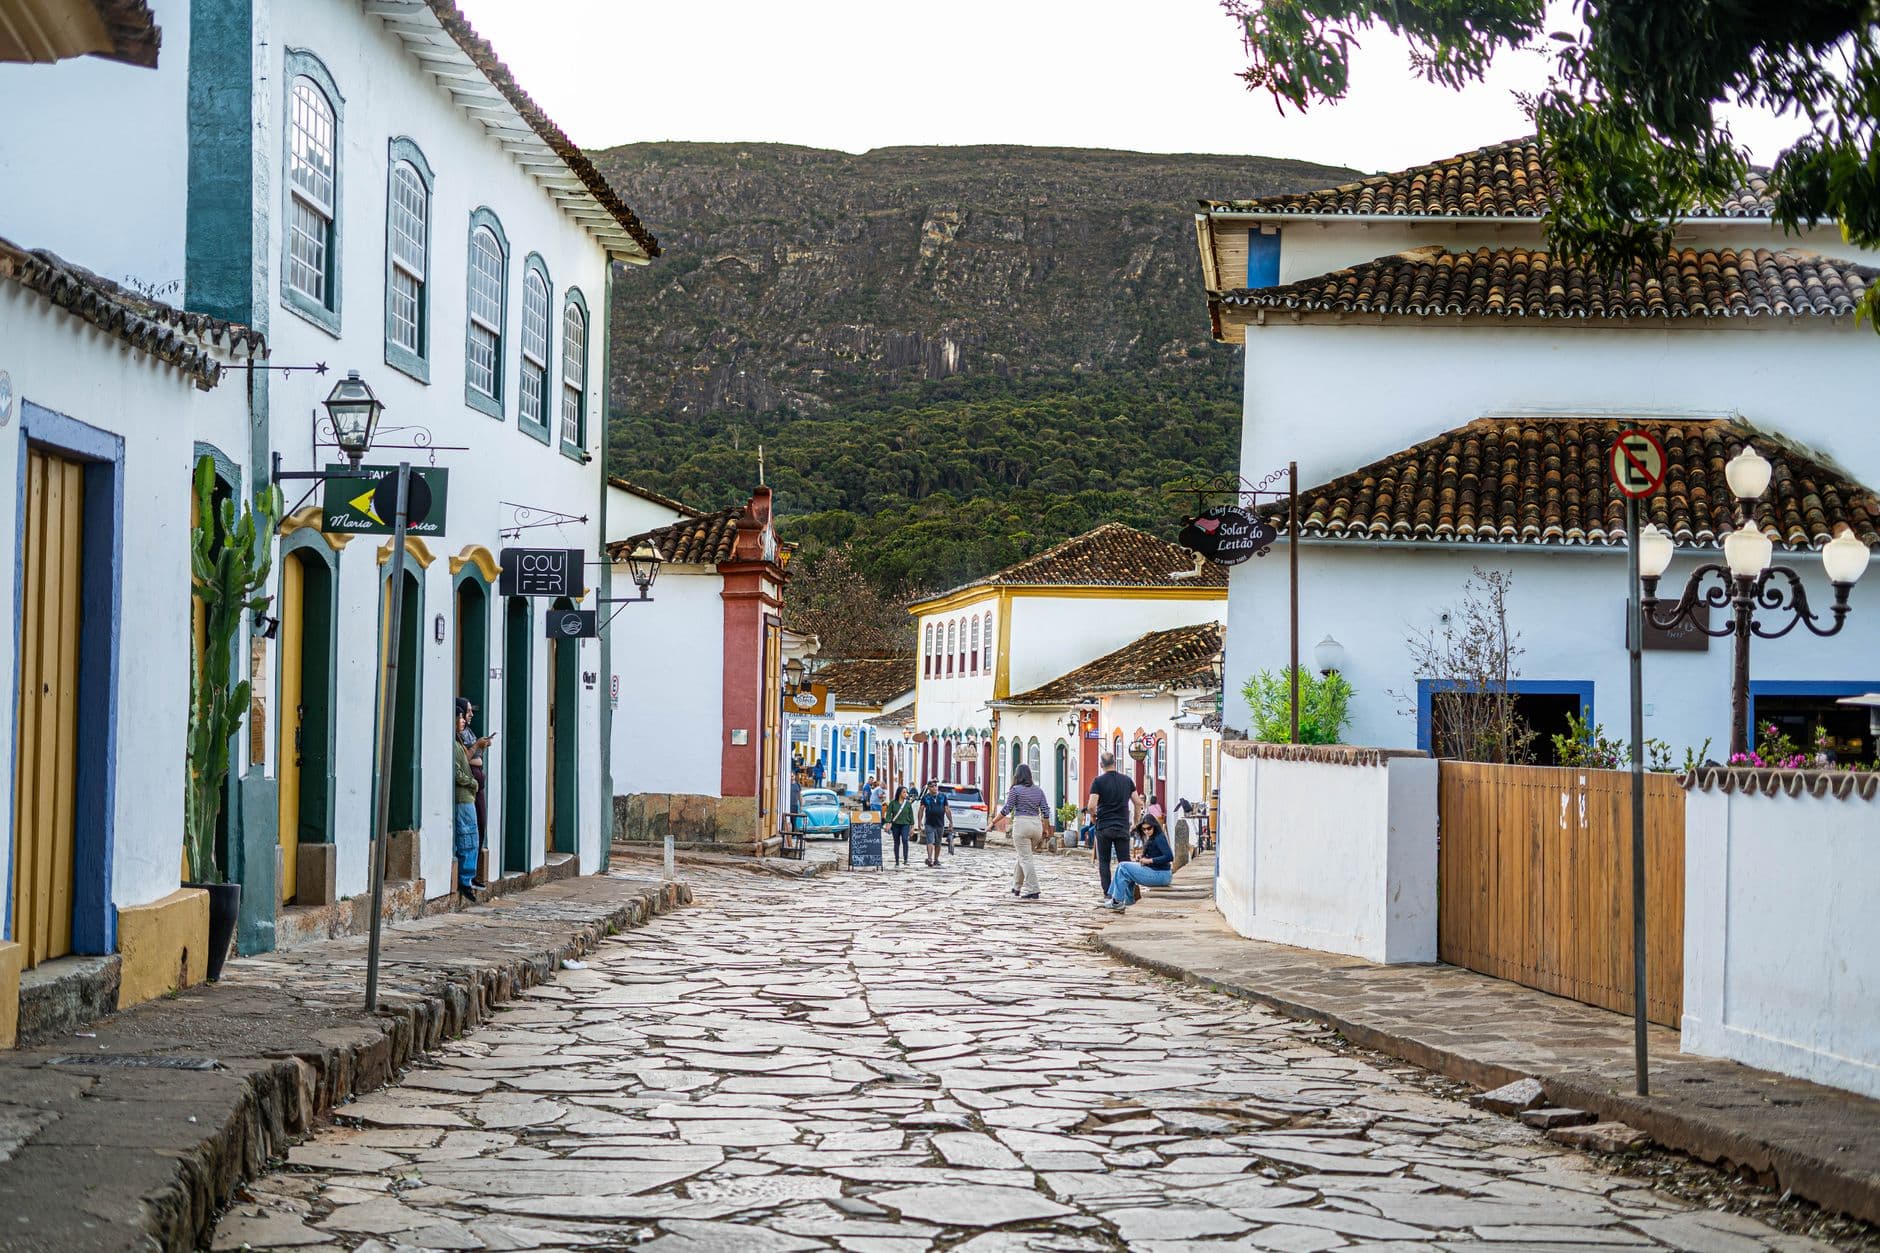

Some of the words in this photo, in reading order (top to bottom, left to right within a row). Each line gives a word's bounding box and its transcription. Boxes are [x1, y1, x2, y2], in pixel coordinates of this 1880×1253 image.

[329, 513, 373, 528] Maria
[1220, 523, 1248, 536] Solar
[1250, 526, 1263, 539] do
[1217, 538, 1253, 551] Leitão
[522, 573, 562, 591] FER
